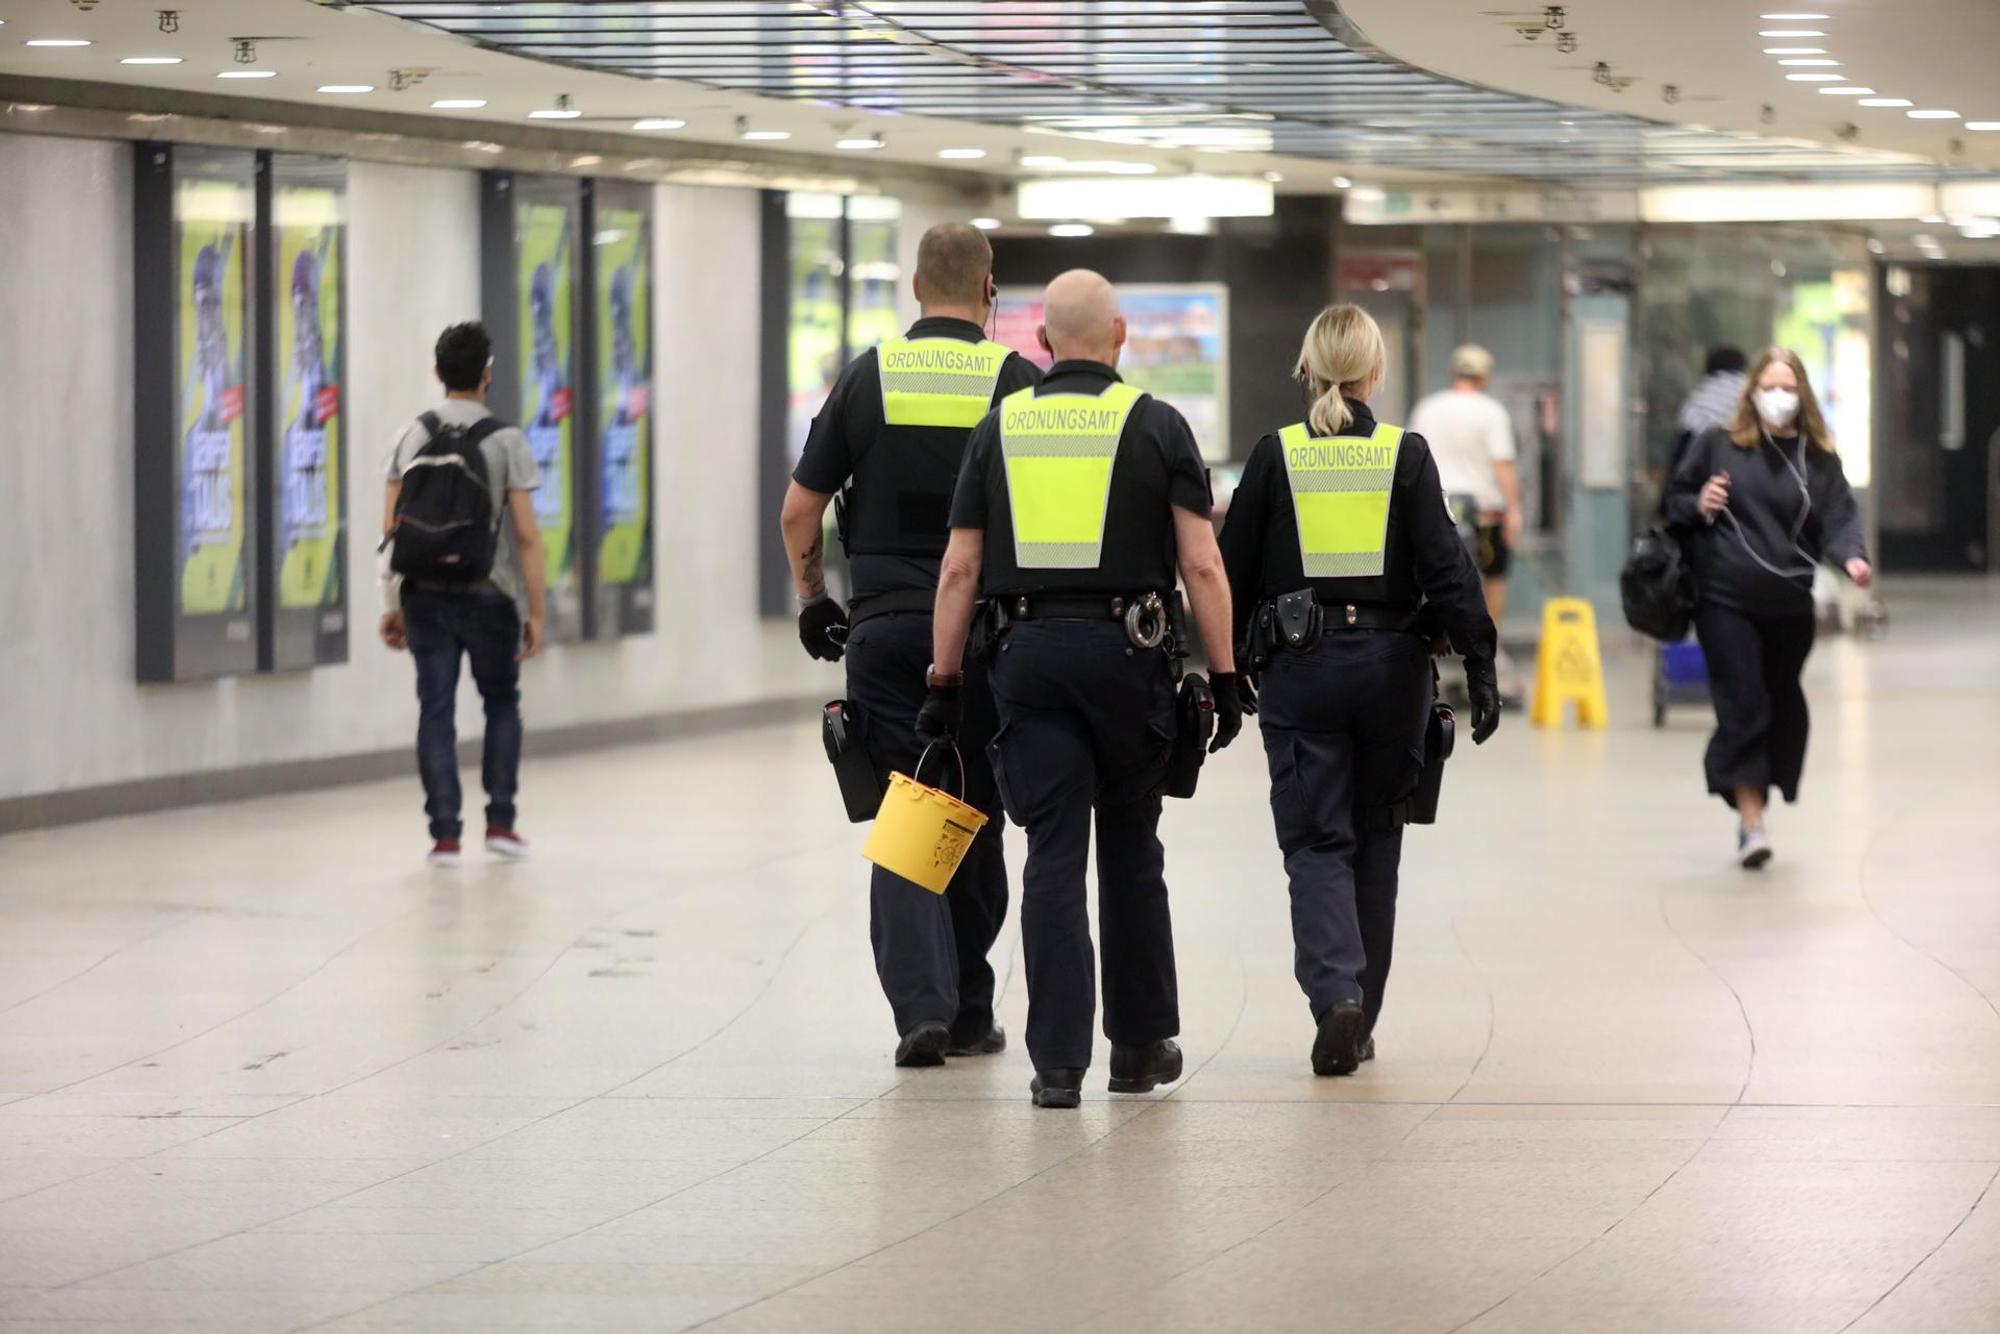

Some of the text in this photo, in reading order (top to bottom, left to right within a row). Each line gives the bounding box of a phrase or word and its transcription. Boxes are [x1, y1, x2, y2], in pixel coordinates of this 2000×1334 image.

[886, 350, 994, 372] ORDNUNGSAMT
[1006, 408, 1119, 431] ORDNUNGSAMT
[1289, 445, 1392, 468] ORDNUNGSAMT
